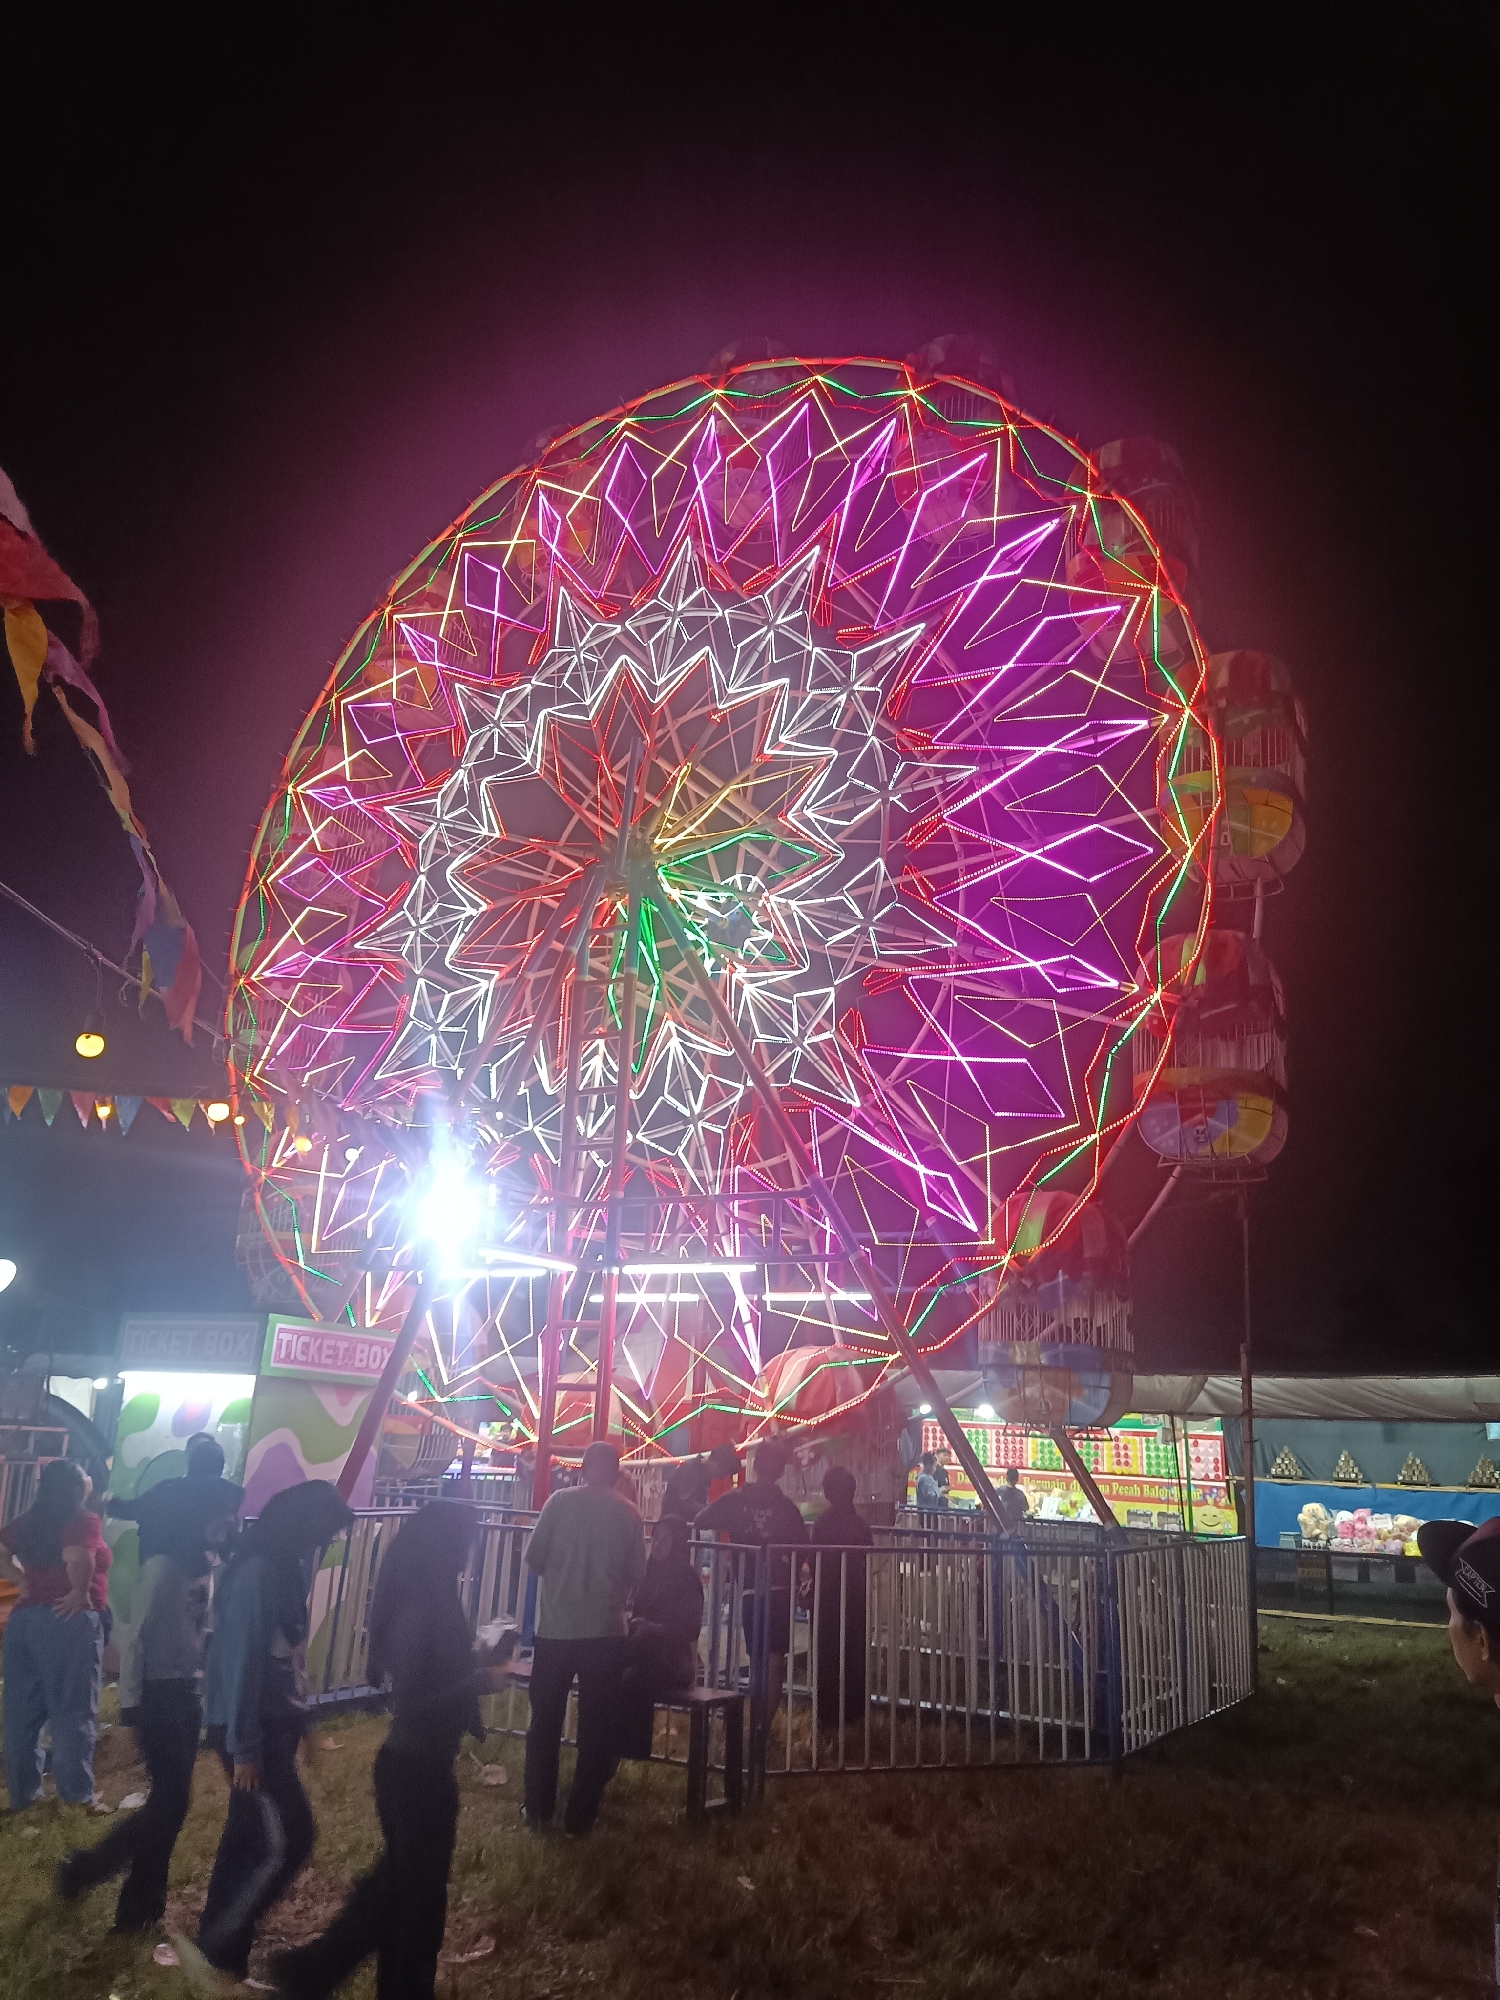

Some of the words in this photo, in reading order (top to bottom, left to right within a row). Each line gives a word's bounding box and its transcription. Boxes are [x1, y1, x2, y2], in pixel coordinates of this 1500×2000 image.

[128, 1328, 199, 1355] TICKET
[203, 1330, 251, 1357] BOX
[278, 1332, 348, 1366] TICKET
[1111, 1482, 1140, 1497] Pecah
[1142, 1484, 1170, 1498] Balon
